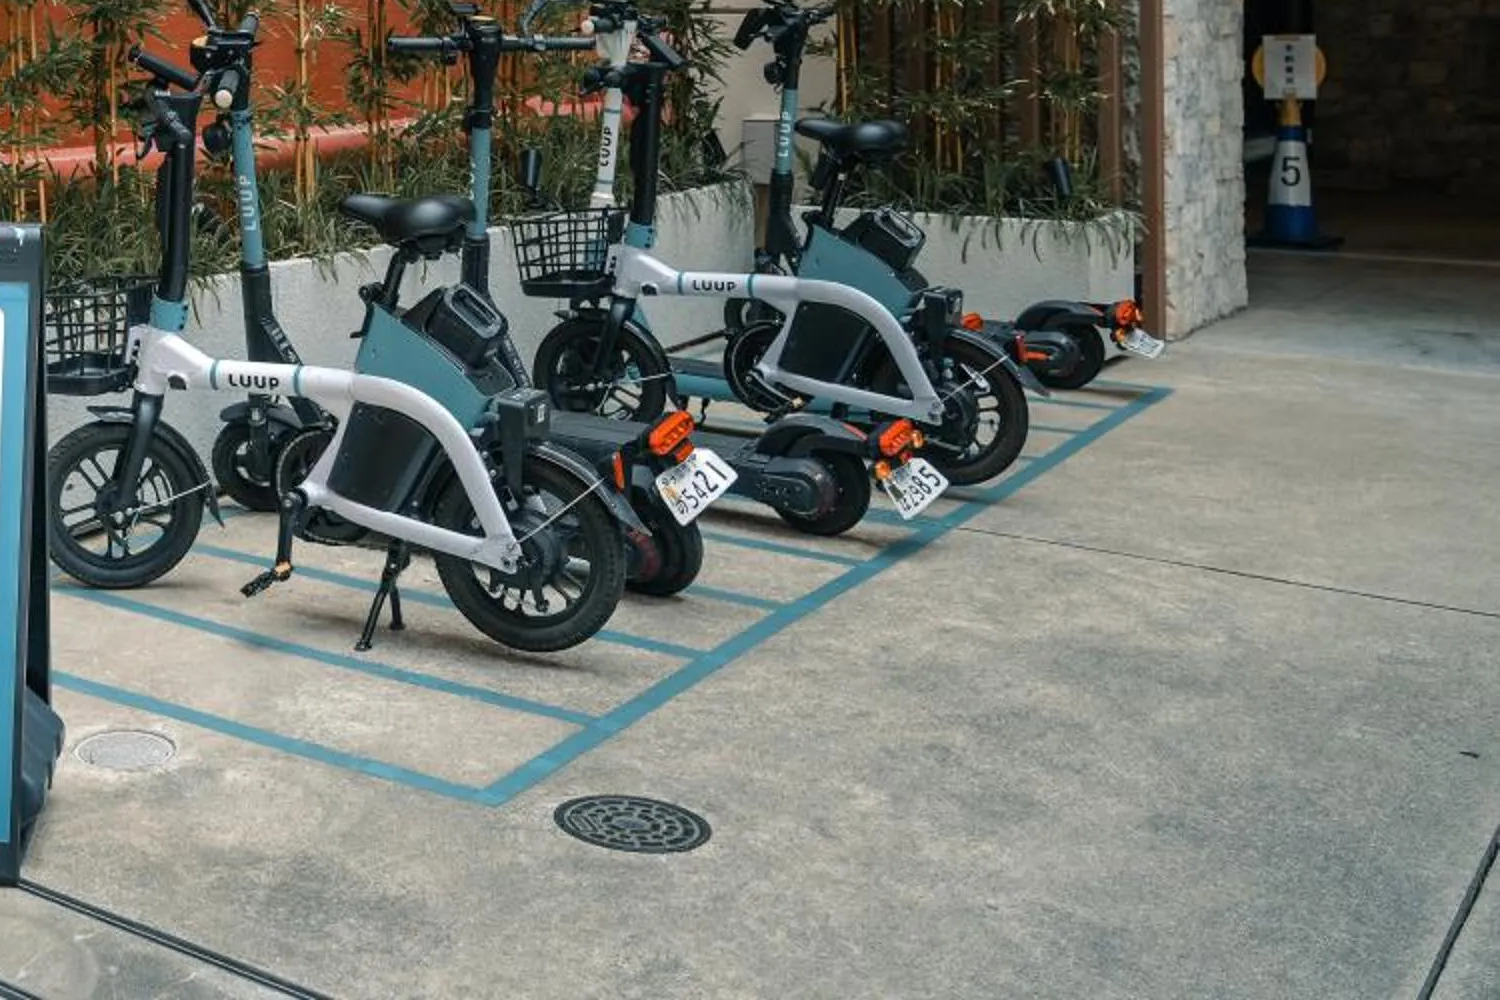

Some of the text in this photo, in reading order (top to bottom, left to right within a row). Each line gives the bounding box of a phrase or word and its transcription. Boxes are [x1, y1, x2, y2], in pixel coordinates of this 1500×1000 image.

[600, 127, 613, 167] LUUP
[778, 111, 790, 158] LUUP
[1281, 156, 1301, 187] 5
[239, 175, 257, 231] LUUP
[693, 279, 738, 291] LUUP
[228, 373, 279, 390] LUUP
